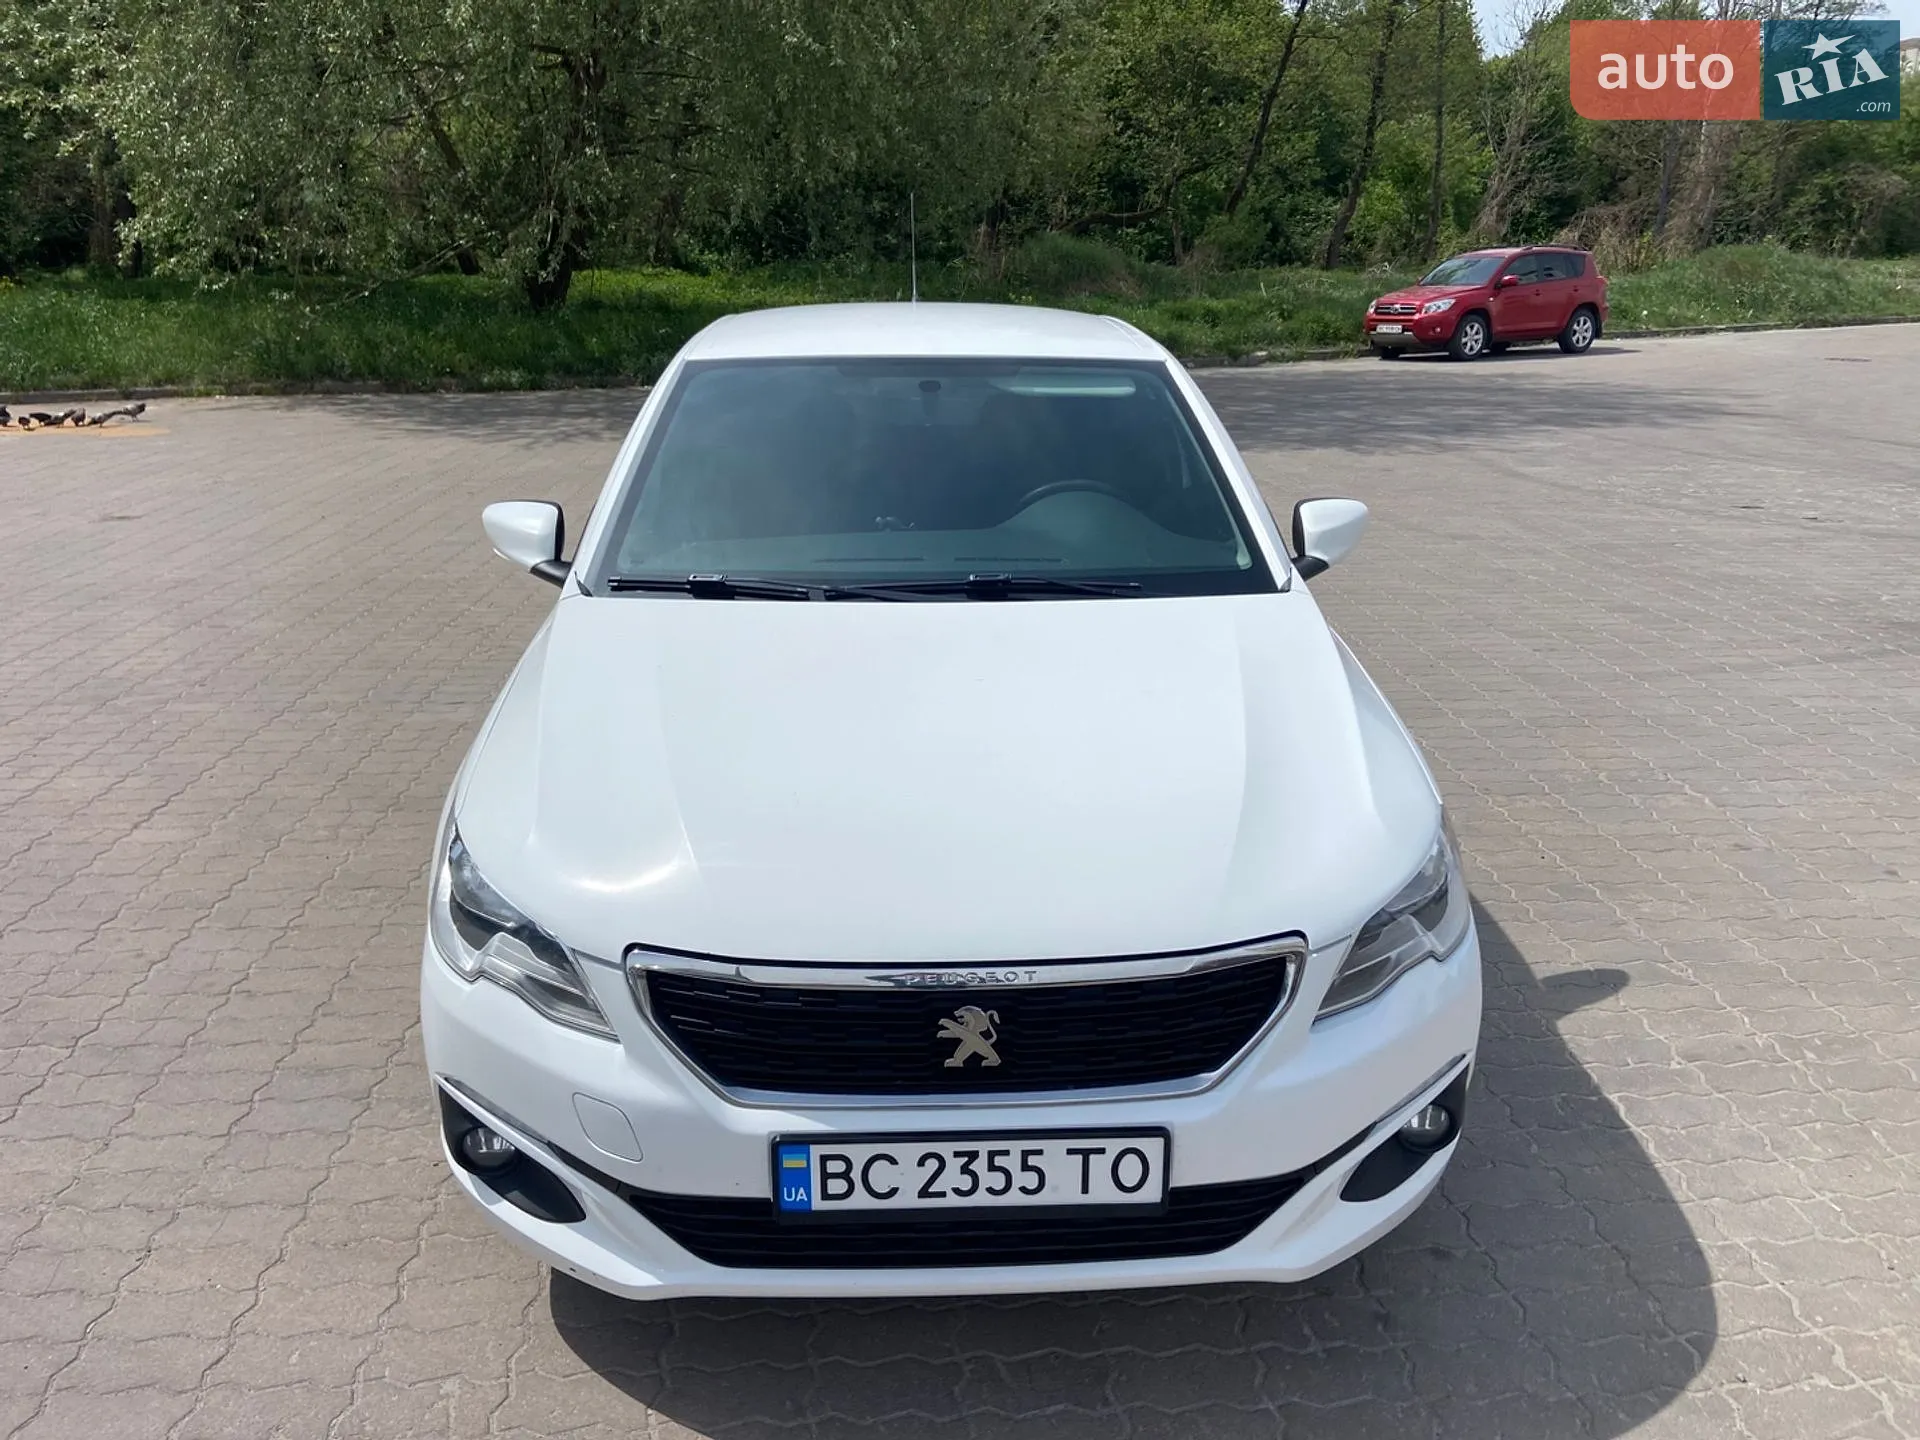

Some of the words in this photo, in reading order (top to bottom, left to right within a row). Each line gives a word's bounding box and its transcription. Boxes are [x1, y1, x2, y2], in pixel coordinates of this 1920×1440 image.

[905, 971, 1037, 985] PEUGEOT
[819, 1152, 900, 1201] BC
[916, 1148, 1046, 1199] 2355
[1066, 1147, 1150, 1194] TO
[783, 1187, 808, 1202] UA
